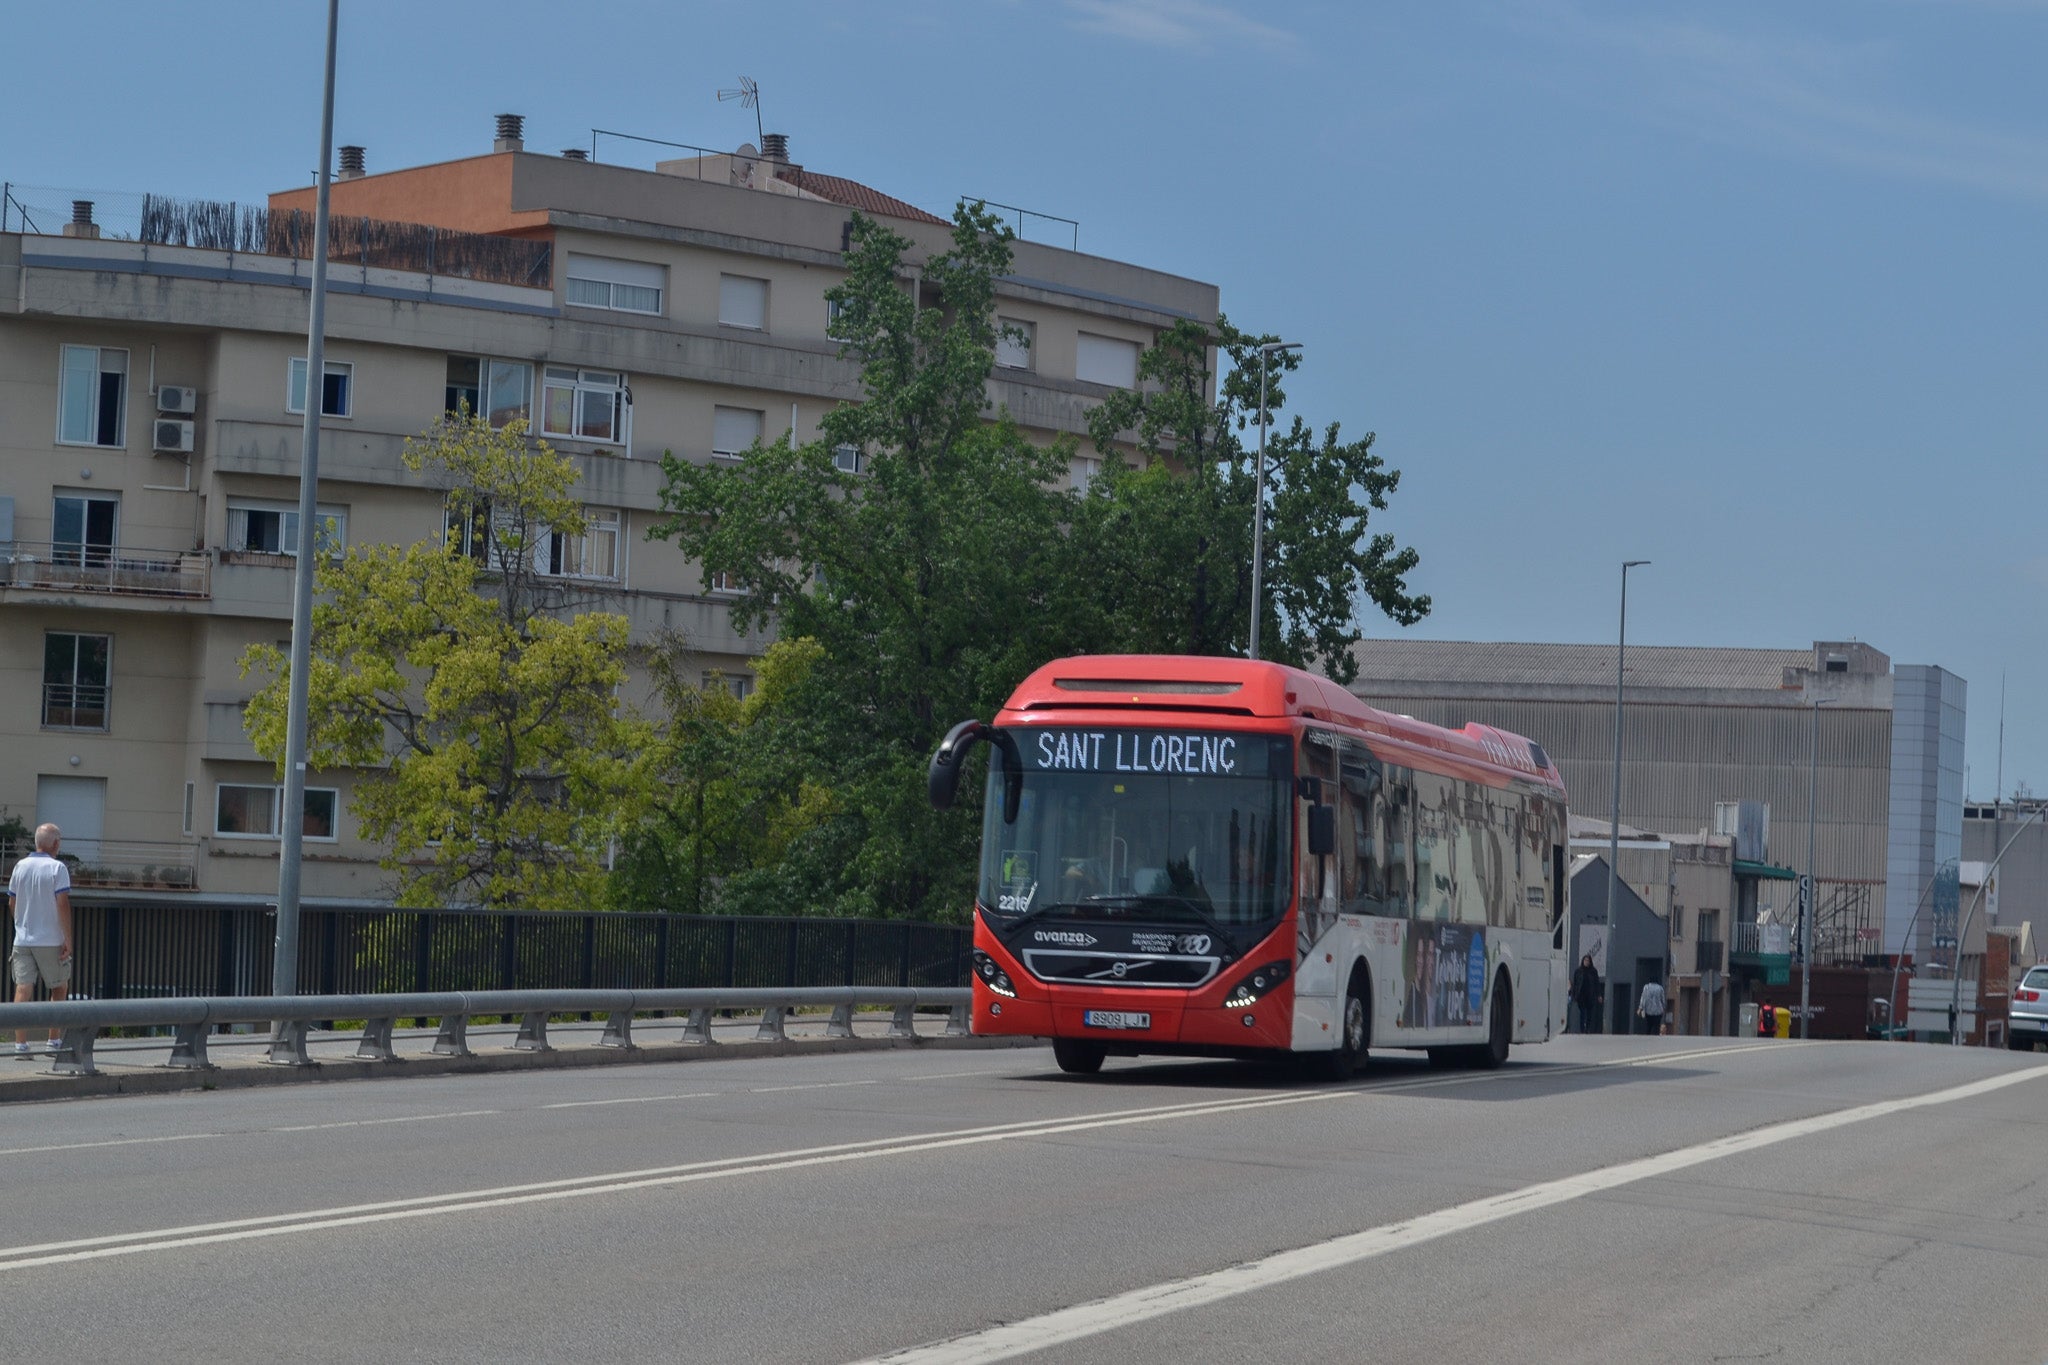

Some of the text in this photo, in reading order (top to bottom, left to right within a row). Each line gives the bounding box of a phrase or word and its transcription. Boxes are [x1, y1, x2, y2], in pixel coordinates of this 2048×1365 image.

[1037, 731, 1236, 773] SANT LLORENÇ
[998, 894, 1030, 912] 2216
[1034, 930, 1086, 943] avanza
[1092, 1012, 1121, 1025] 8909
